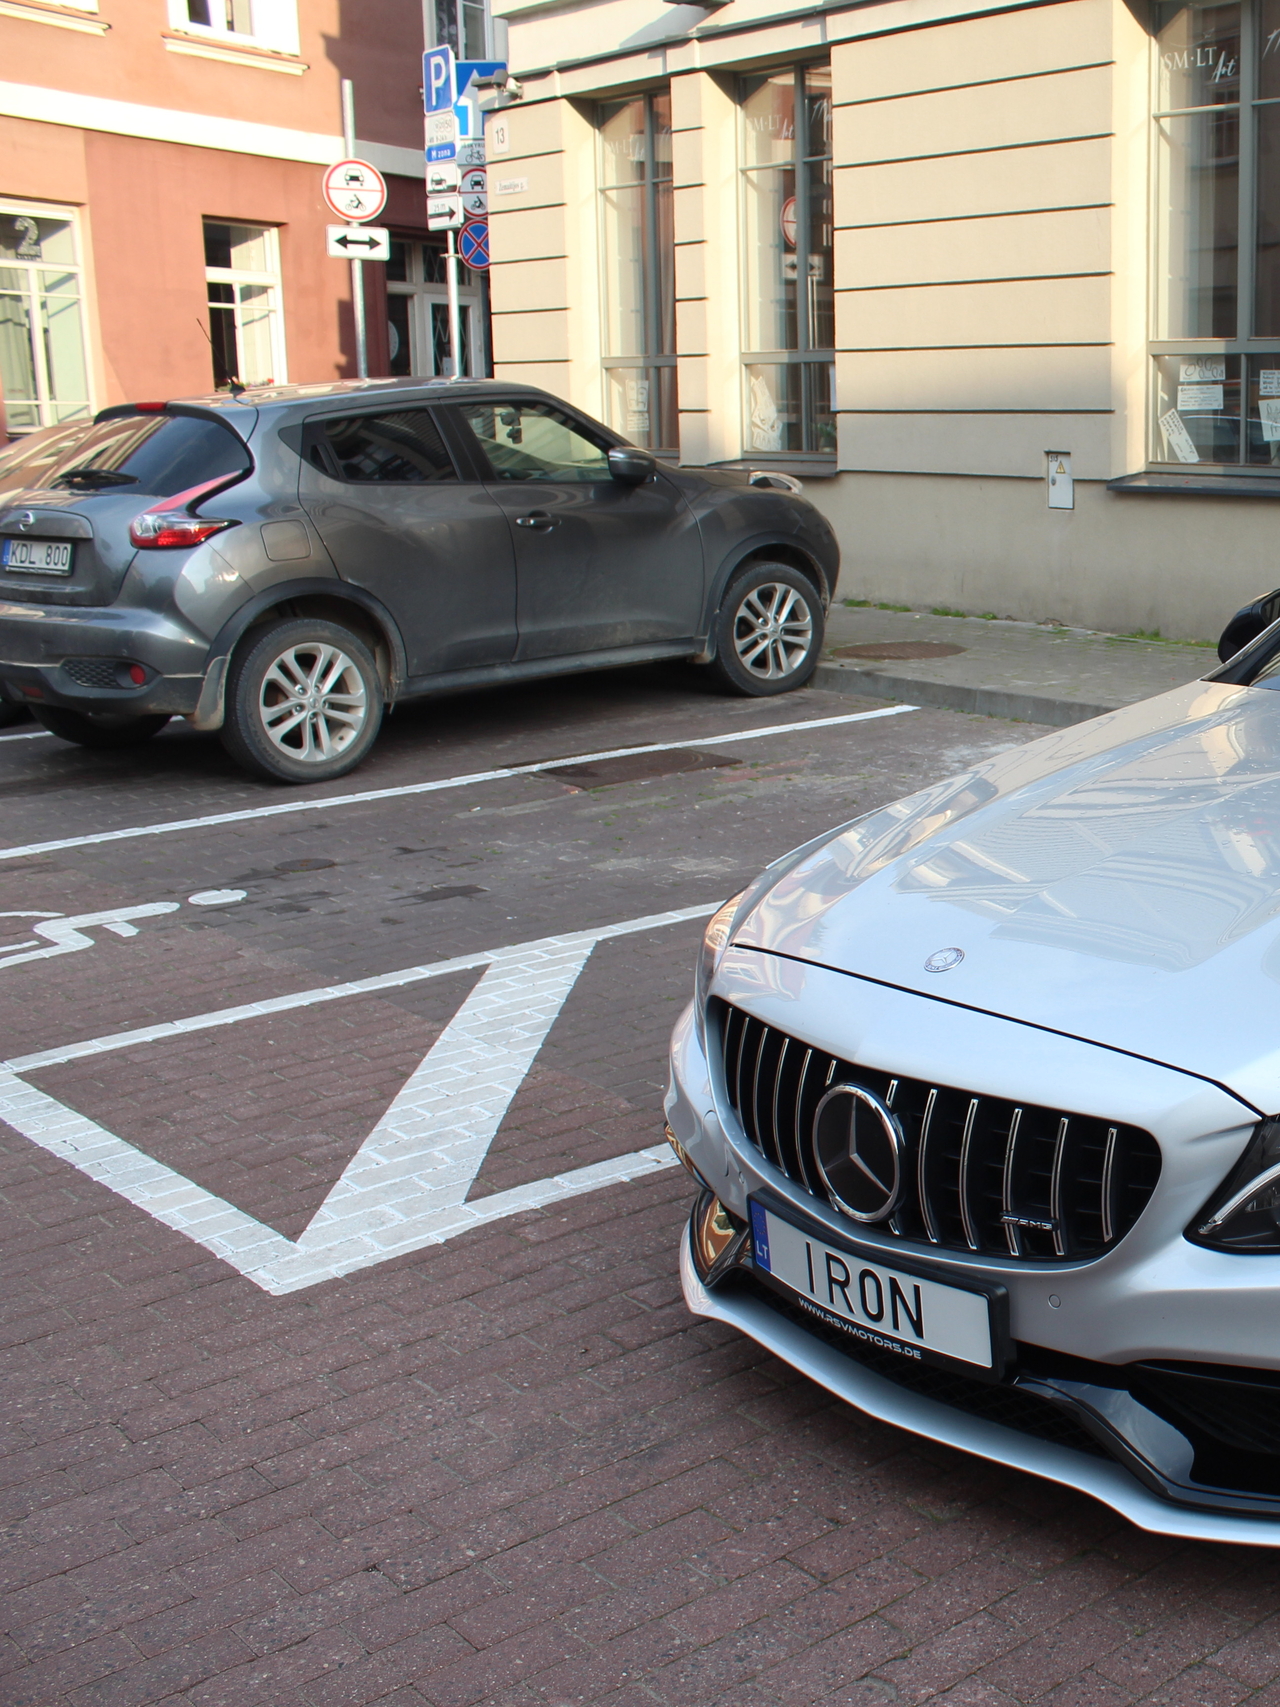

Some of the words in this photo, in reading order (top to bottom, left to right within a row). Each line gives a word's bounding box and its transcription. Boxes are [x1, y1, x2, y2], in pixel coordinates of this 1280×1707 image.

[430, 55, 446, 106] P
[1210, 50, 1236, 83] Art
[495, 127, 505, 144] 13
[14, 216, 42, 256] 2
[10, 542, 36, 565] KDL
[45, 544, 69, 567] 800
[1017, 1218, 1053, 1231] AMG
[756, 1240, 769, 1260] LT
[805, 1240, 925, 1340] IRON
[798, 1297, 922, 1360] WWW.RSVMOTORS.DE
